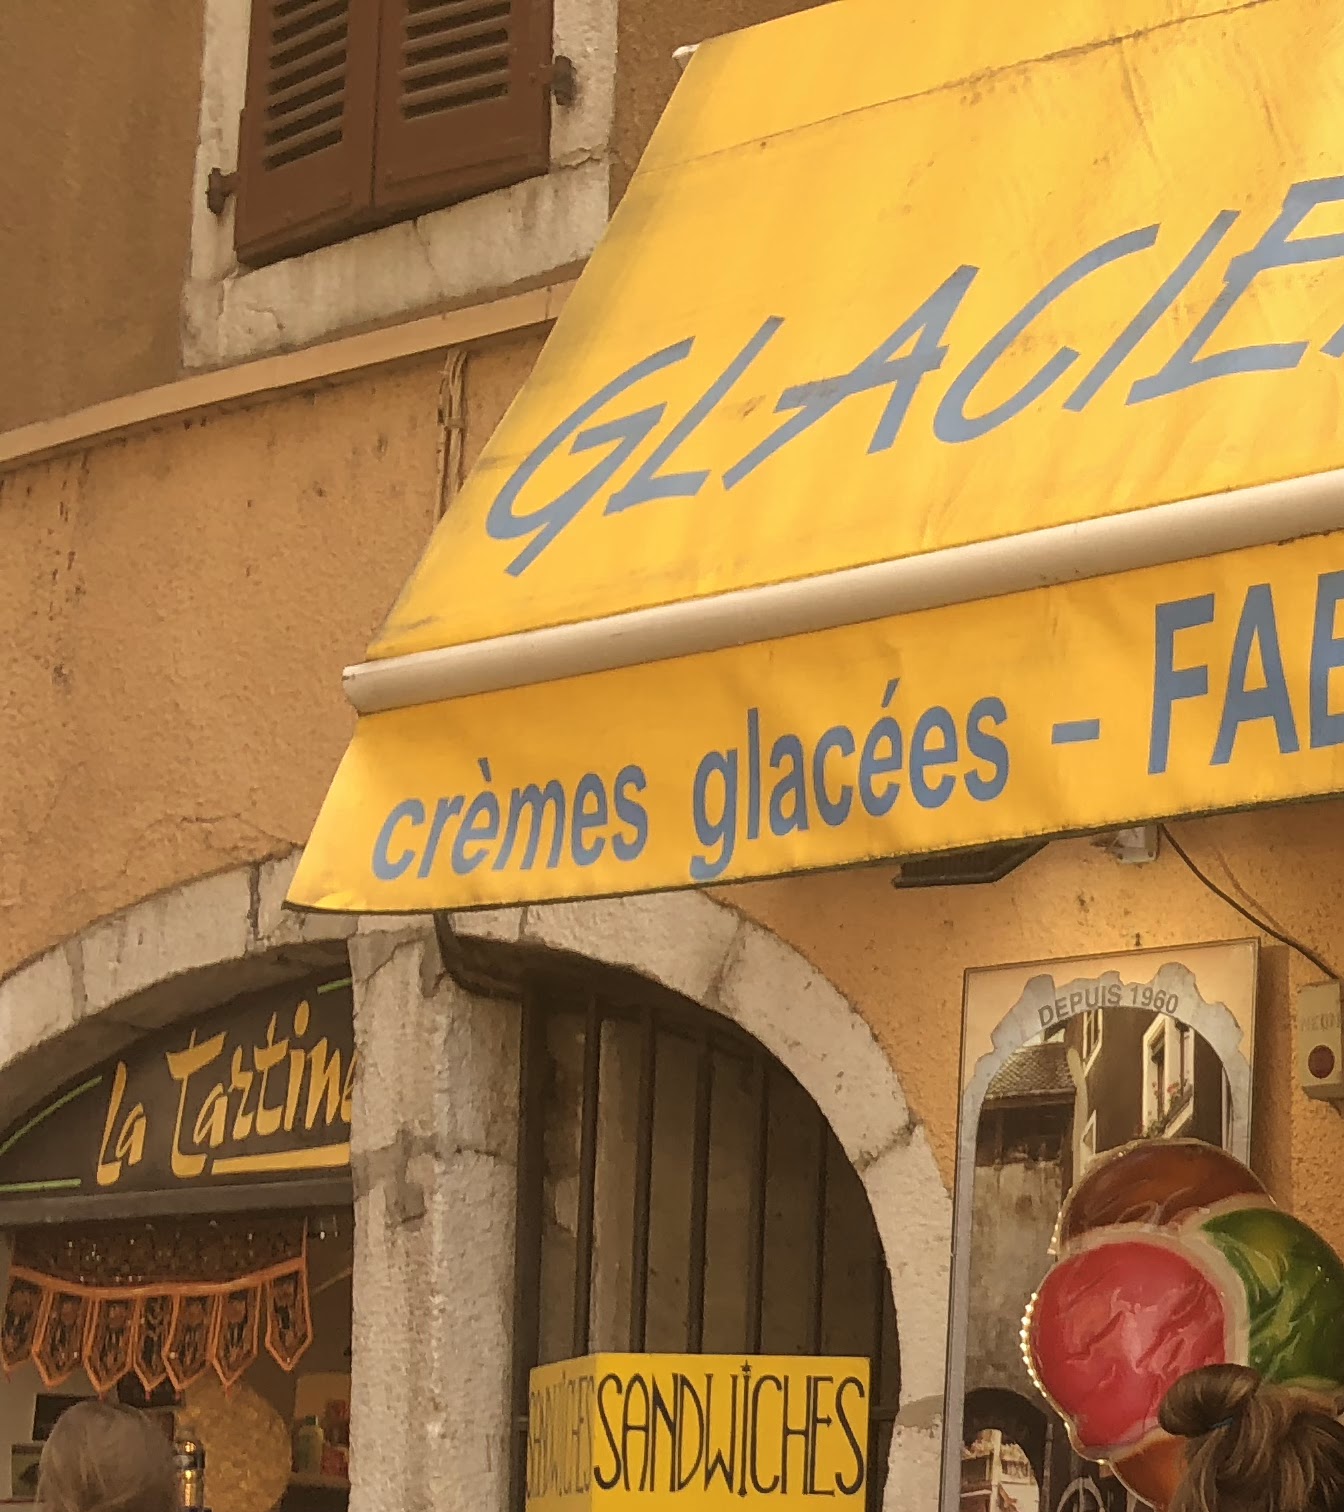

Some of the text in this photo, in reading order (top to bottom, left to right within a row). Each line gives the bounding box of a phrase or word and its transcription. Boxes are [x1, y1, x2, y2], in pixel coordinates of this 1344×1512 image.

[370, 757, 650, 881] crèmes
[690, 677, 1010, 881] glacées
[1037, 983, 1179, 1027] DEPUIS 1960
